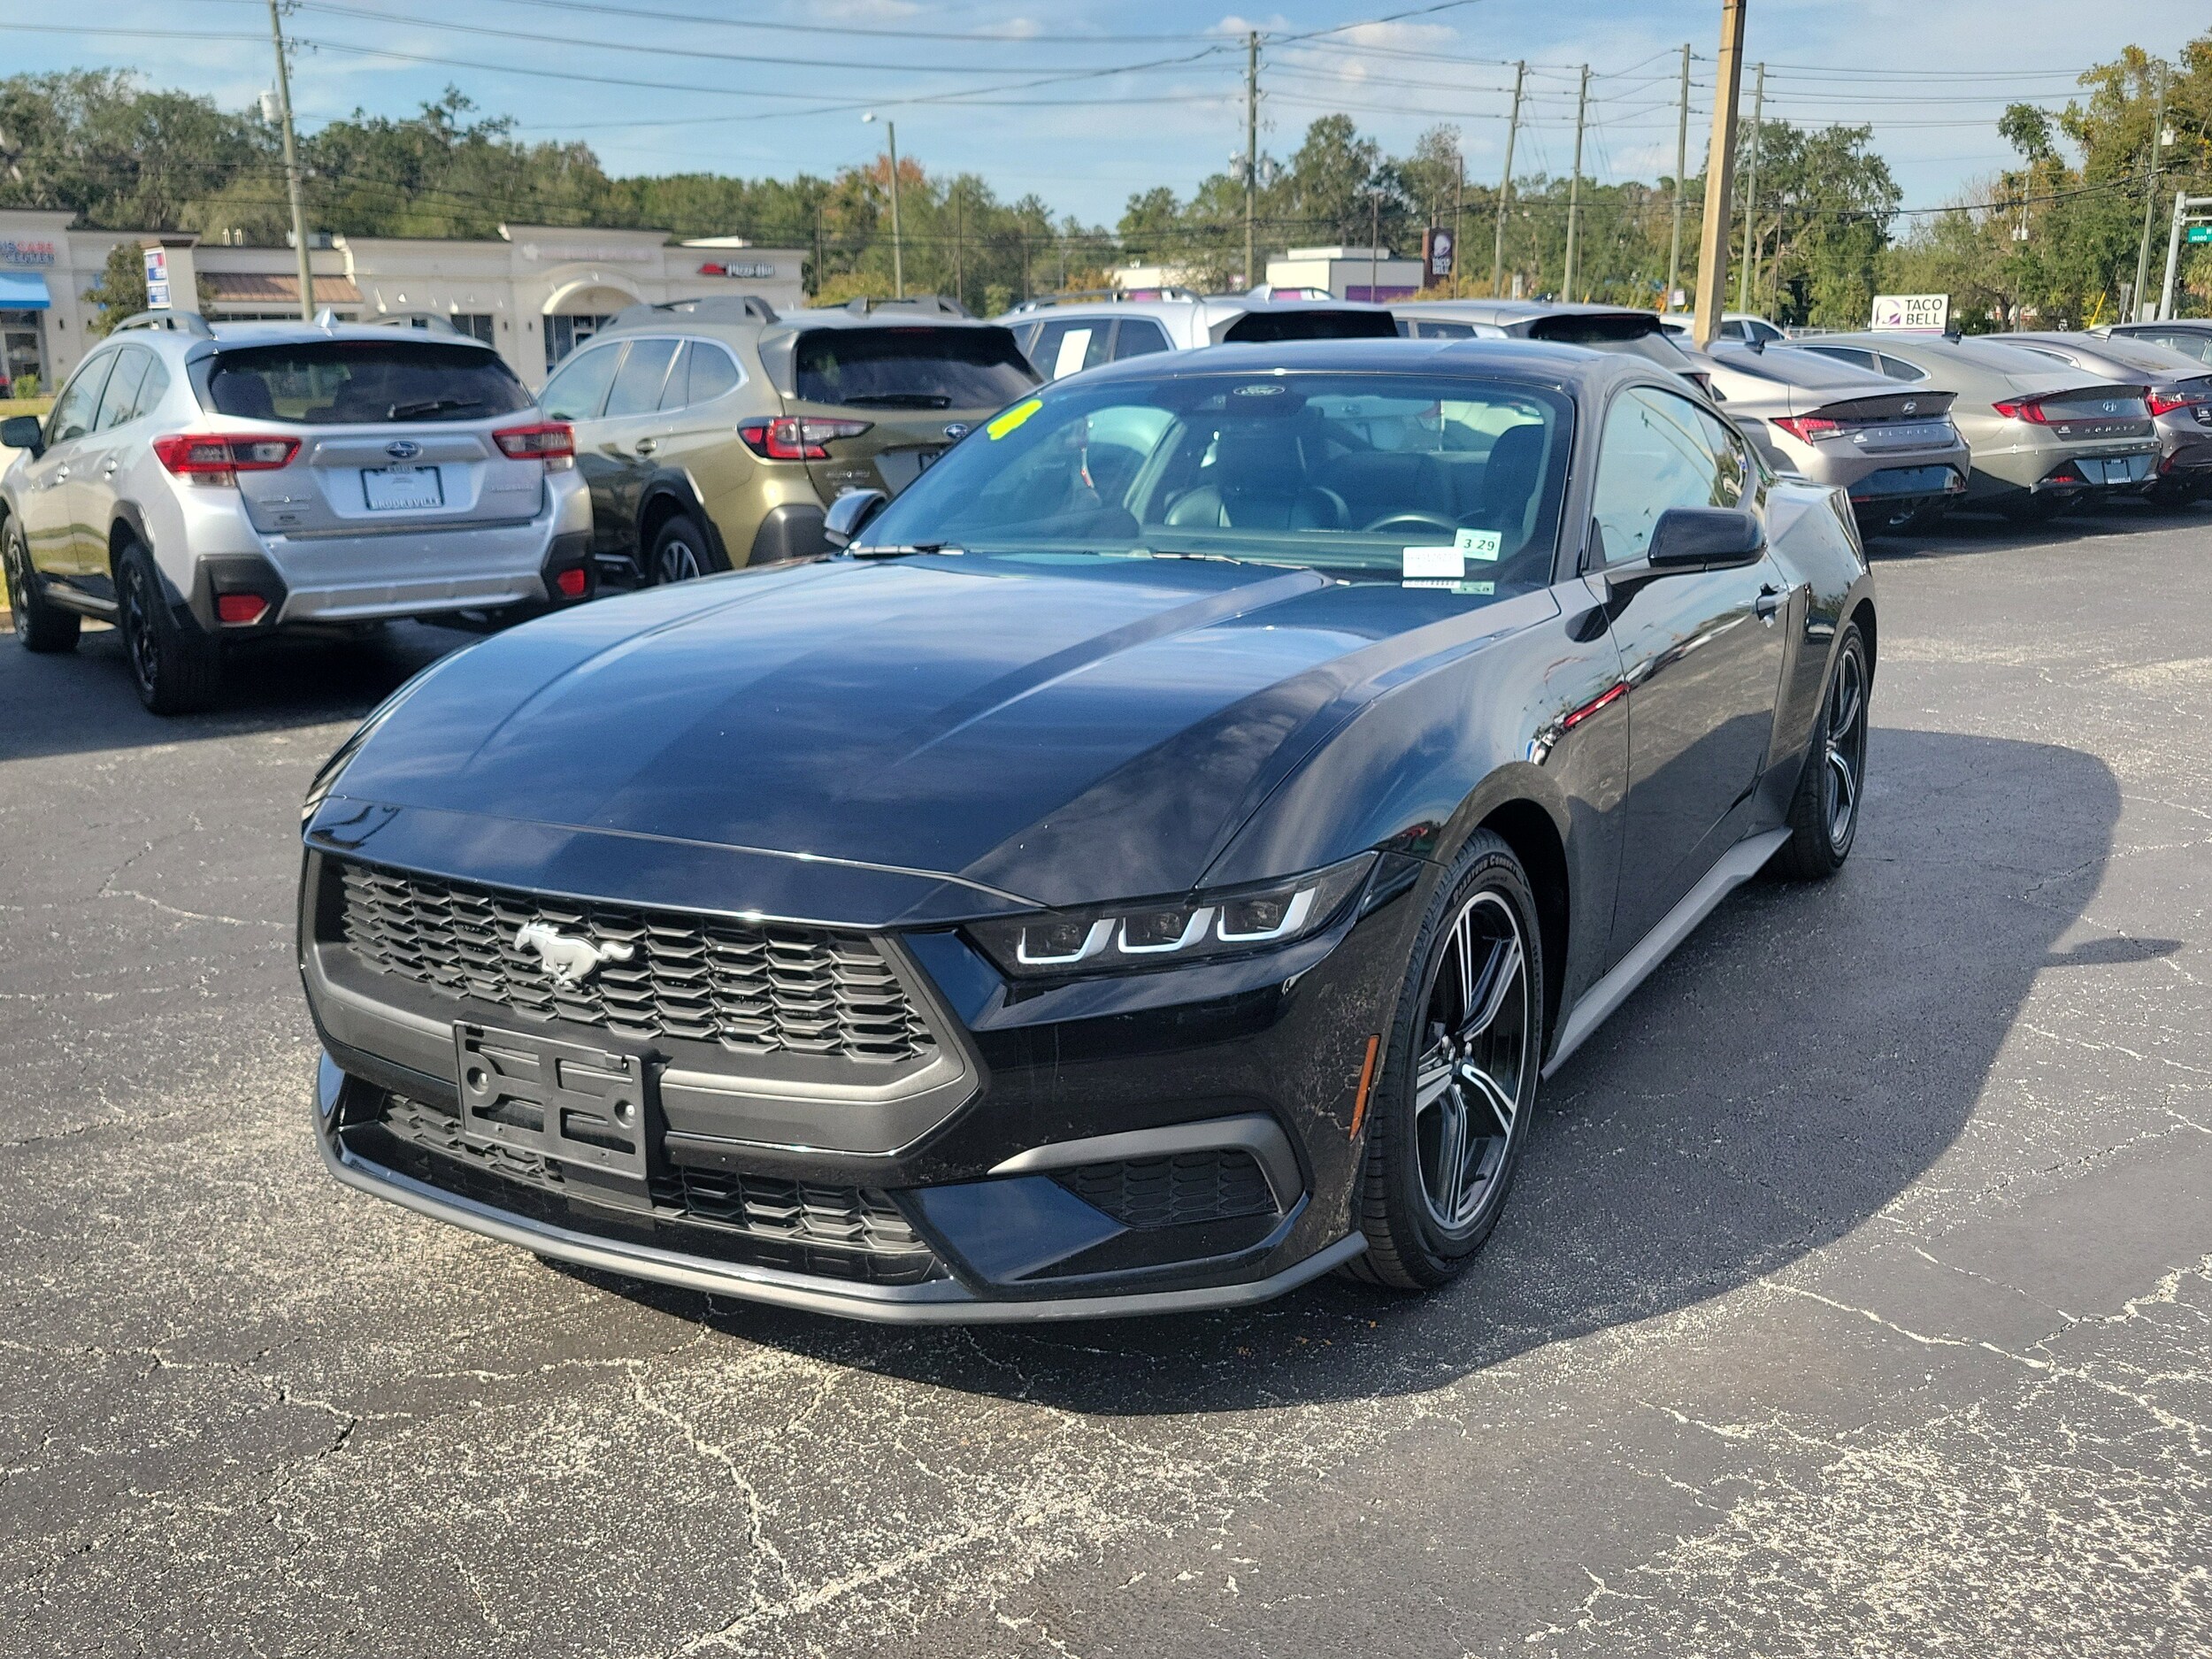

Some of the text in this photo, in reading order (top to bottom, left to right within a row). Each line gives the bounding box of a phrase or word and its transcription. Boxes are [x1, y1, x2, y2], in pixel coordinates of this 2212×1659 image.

[1905, 299, 1943, 311] TACO
[1906, 312, 1940, 325] BELL
[371, 496, 442, 510] BROOKSVILLE
[1463, 538, 1495, 551] 3 29
